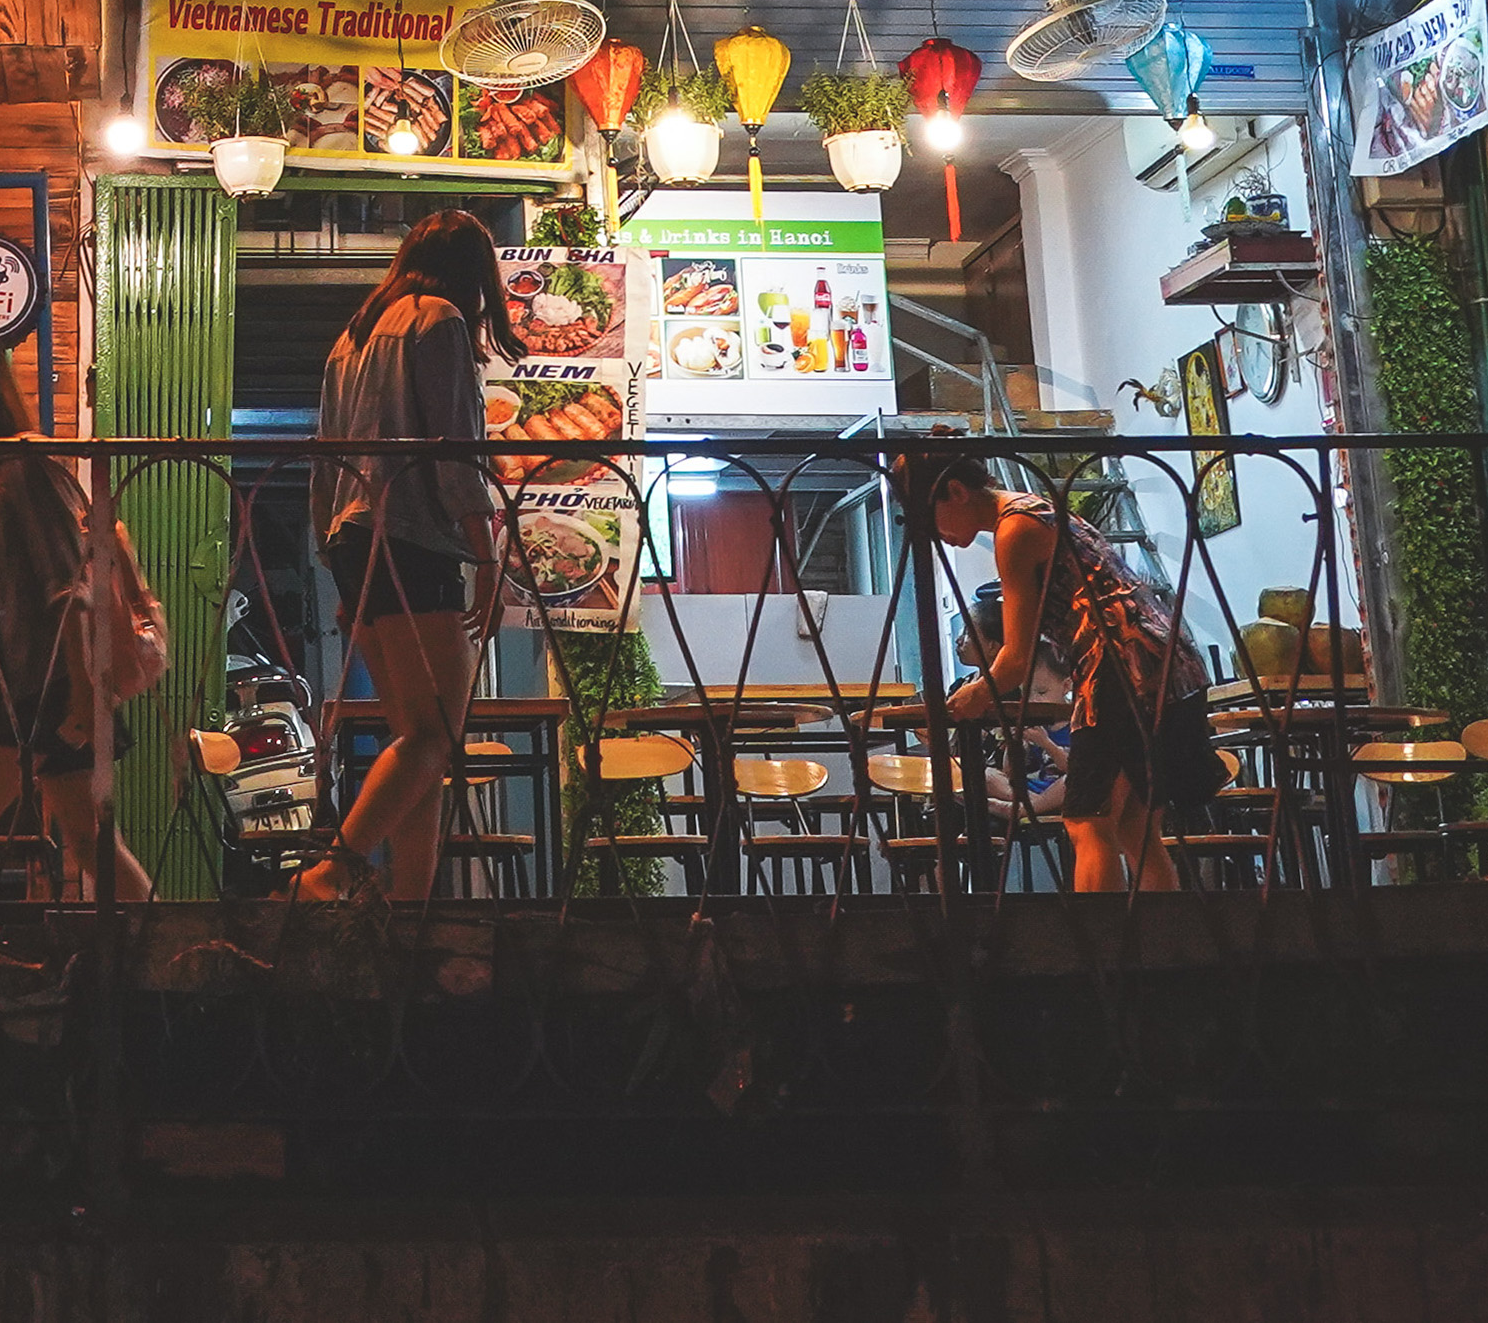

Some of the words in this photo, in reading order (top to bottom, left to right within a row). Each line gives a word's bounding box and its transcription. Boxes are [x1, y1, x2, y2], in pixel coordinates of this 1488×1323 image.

[318, 1, 454, 42] Traditional
[659, 229, 730, 245] Drinks
[737, 229, 764, 245] in
[769, 229, 834, 246] Hanoi
[500, 248, 553, 262] BUN
[512, 364, 597, 379] NEM
